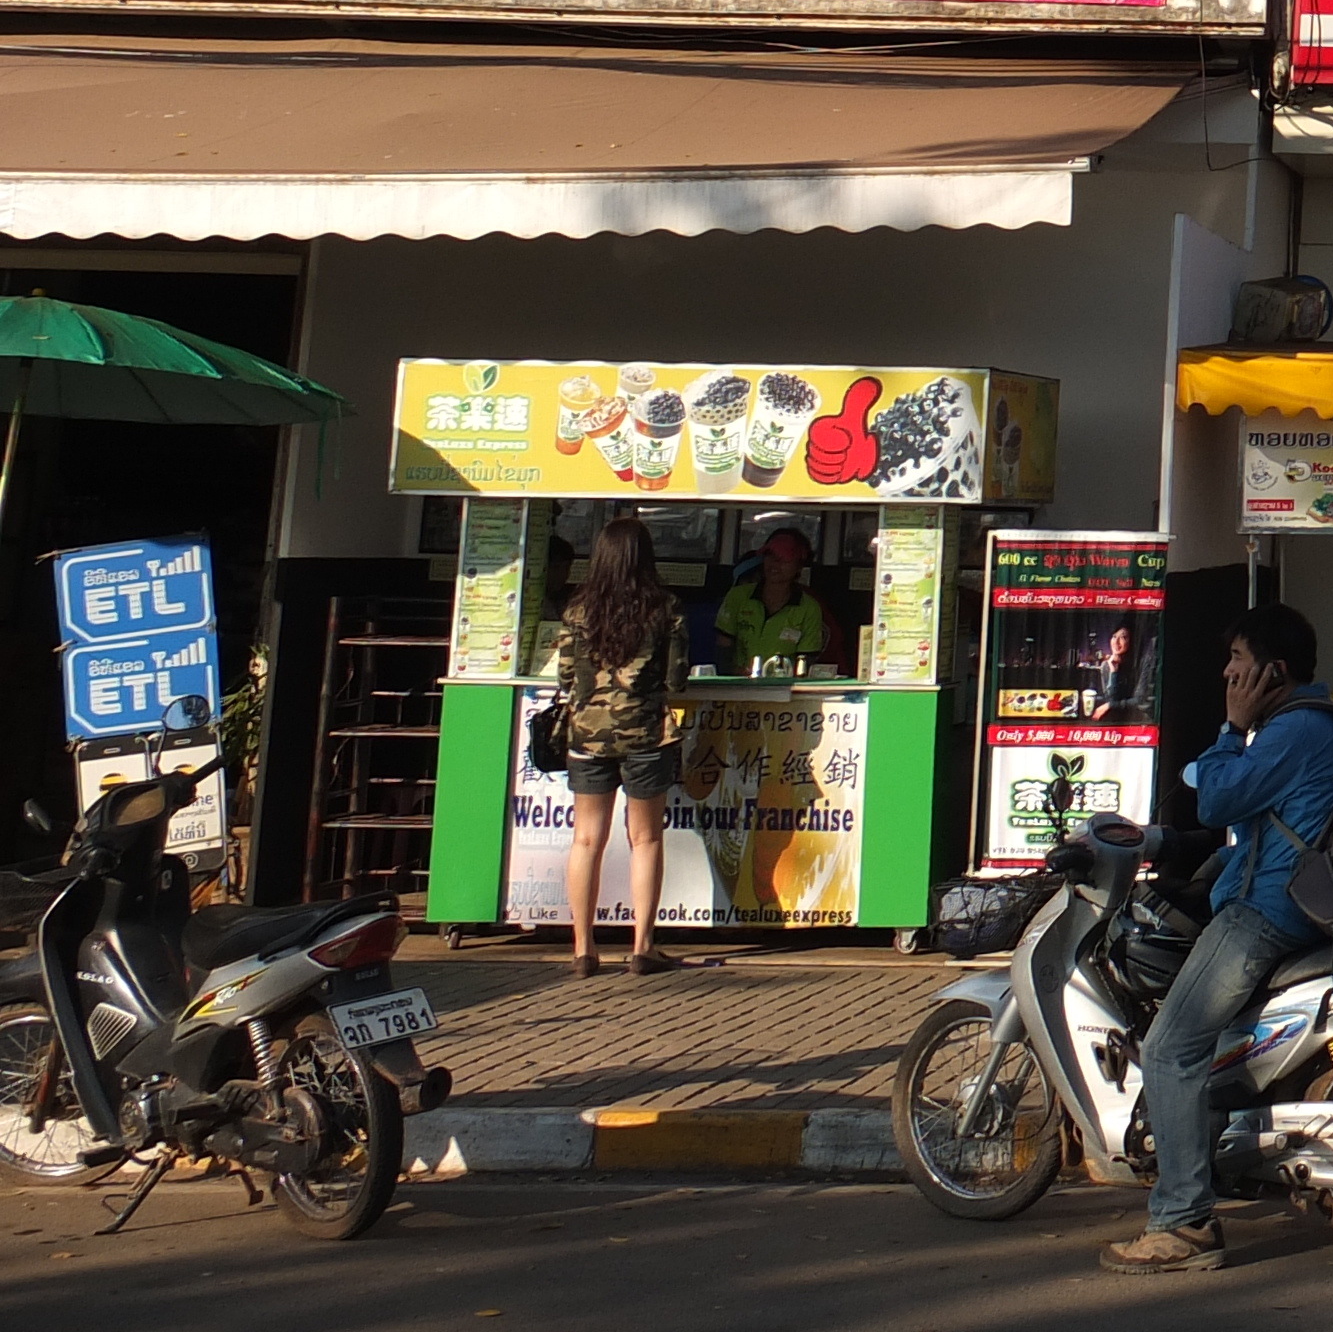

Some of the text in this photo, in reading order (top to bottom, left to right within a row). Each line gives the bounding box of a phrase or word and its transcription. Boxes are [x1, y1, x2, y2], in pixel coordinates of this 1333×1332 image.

[84, 579, 186, 624] ETL
[89, 671, 186, 715] ETL
[514, 795, 574, 828] Welco
[1013, 780, 1120, 813] 茶速
[664, 798, 695, 829] oin
[743, 795, 854, 832] Franchise
[529, 907, 559, 920] Like
[378, 1007, 432, 1037] 7981
[1077, 1024, 1111, 1035] HON
